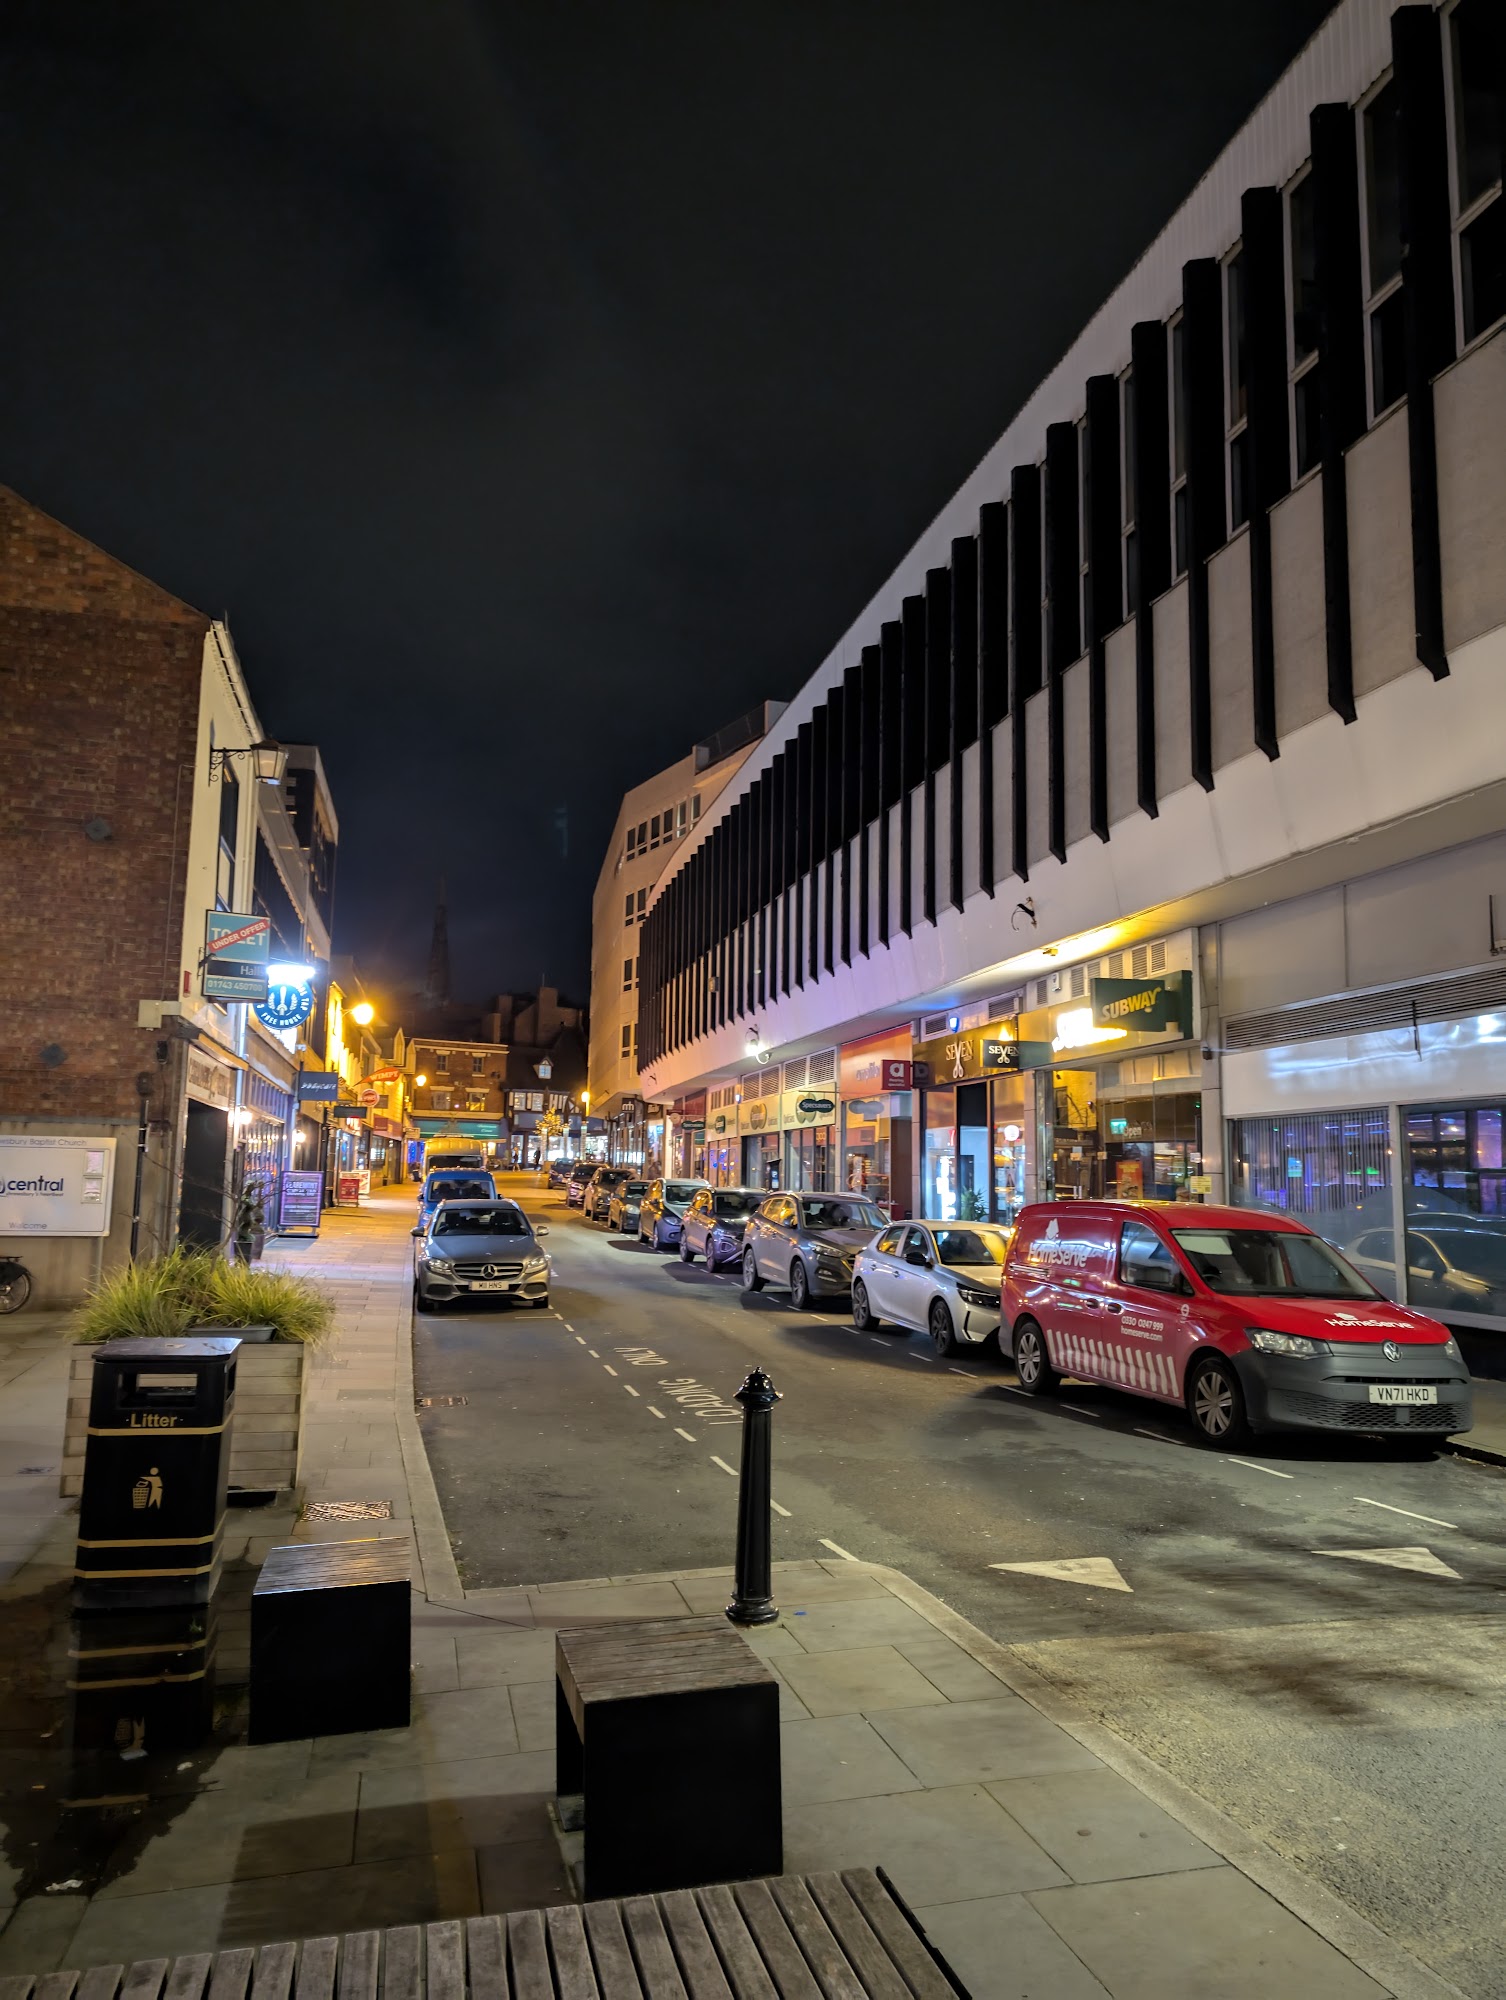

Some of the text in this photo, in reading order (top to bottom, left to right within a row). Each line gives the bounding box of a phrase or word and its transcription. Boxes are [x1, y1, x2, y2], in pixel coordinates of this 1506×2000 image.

[212, 922, 266, 949] UNDER OFFER
[237, 933, 266, 945] ET
[1102, 987, 1162, 1020] SUBWAY
[801, 1101, 832, 1109] Specsavers
[7, 1175, 64, 1191] central
[1152, 1322, 1164, 1332] 999
[1324, 1319, 1415, 1329] HomeServe
[1378, 1387, 1429, 1401] VN71 HKD
[130, 1413, 178, 1428] Litter
